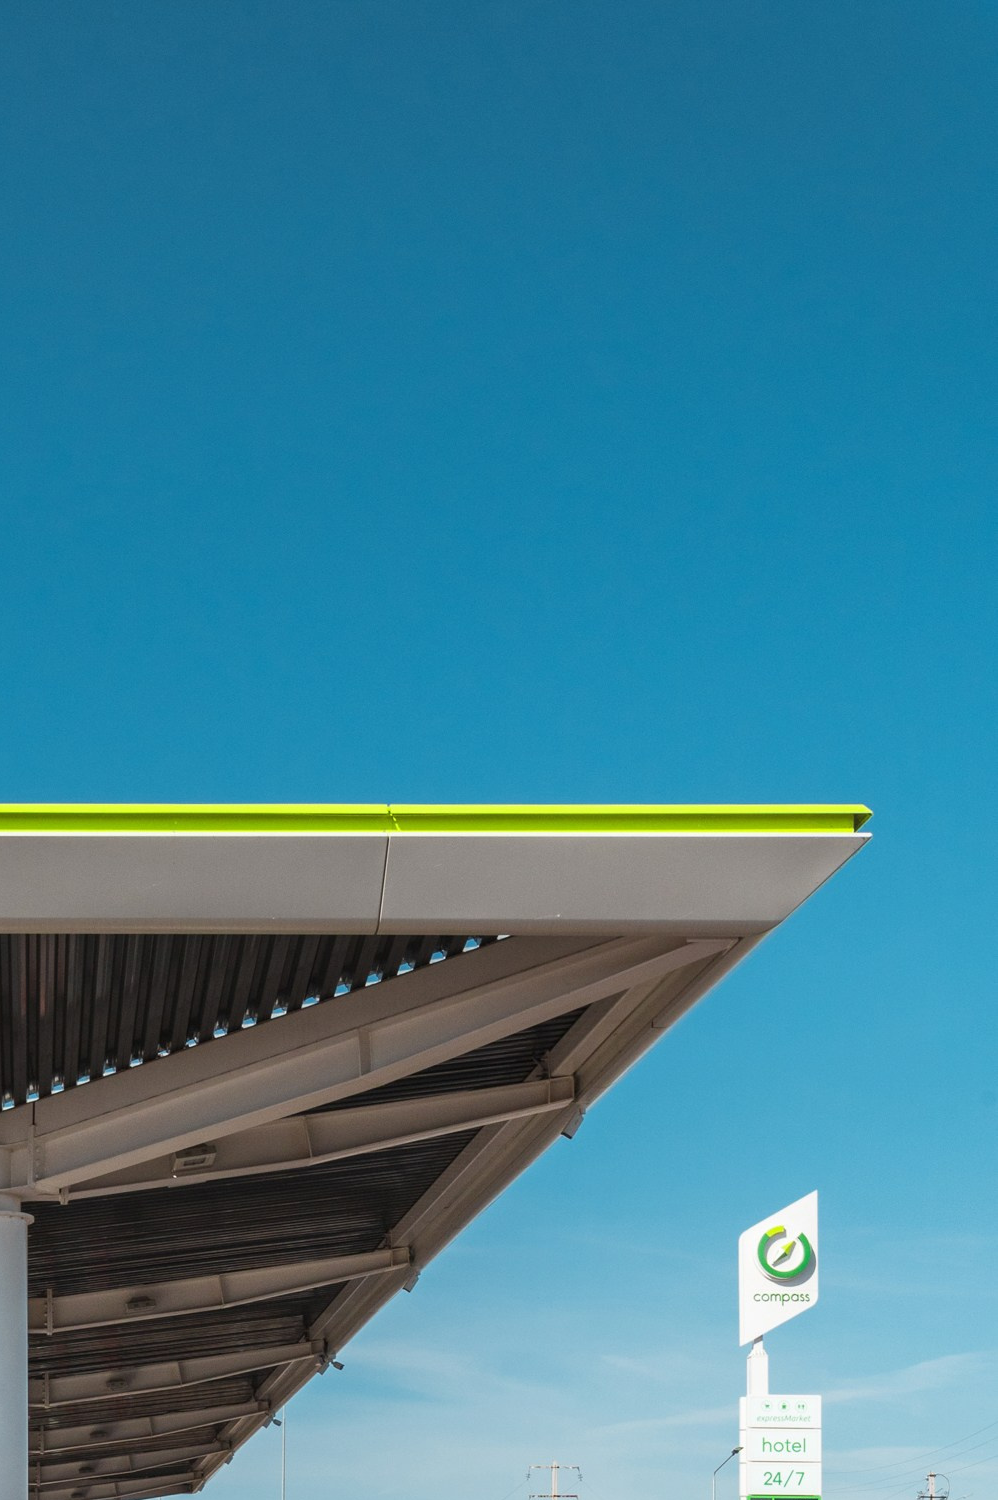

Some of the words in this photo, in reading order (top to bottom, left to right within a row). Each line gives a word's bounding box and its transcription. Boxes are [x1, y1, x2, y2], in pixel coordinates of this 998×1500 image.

[753, 1293, 810, 1306] compass
[756, 1415, 811, 1423] expressMarket
[762, 1437, 806, 1453] hotel
[763, 1469, 805, 1488] 24/7
